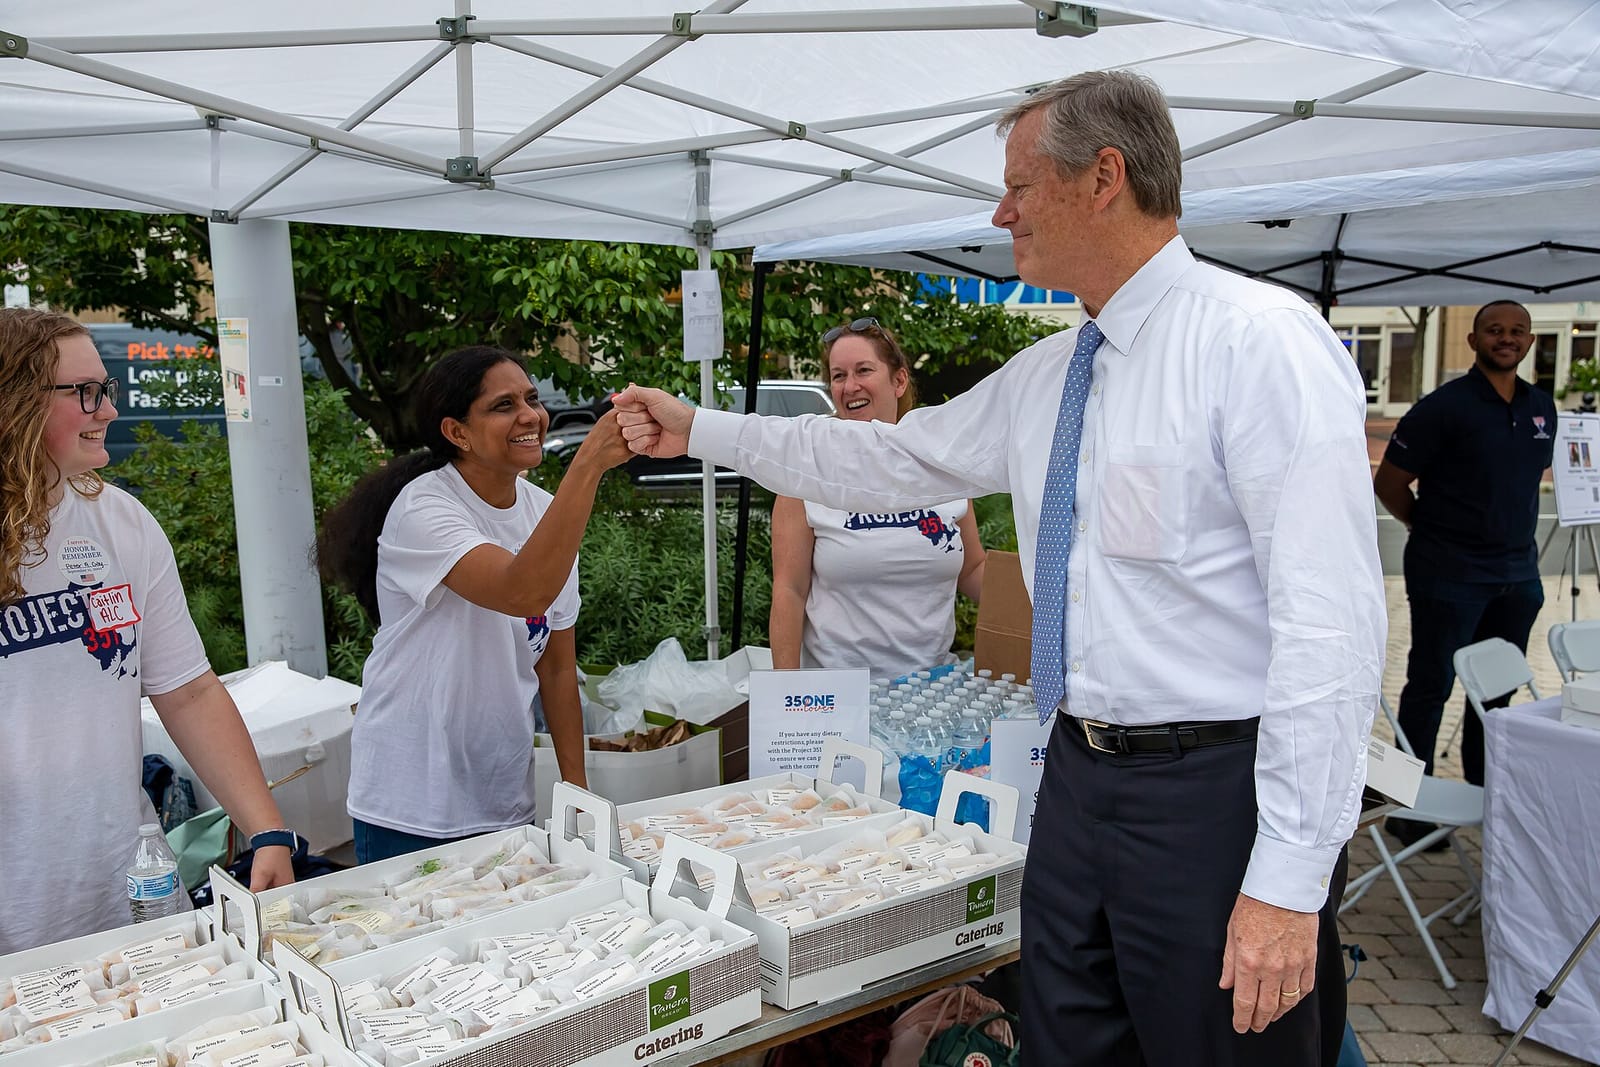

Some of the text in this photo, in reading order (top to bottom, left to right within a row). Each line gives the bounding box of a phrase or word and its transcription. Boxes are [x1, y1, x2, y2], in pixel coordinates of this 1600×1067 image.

[127, 342, 169, 360] Pick
[919, 517, 944, 535] 351
[61, 552, 103, 561] REMEMBER
[91, 592, 124, 608] Caitlin
[100, 606, 124, 624] ALC
[822, 730, 842, 738] dietary
[967, 898, 994, 911] Panera
[955, 921, 1004, 946] Catering
[651, 996, 689, 1016] Panera
[634, 1022, 704, 1061] Catering
